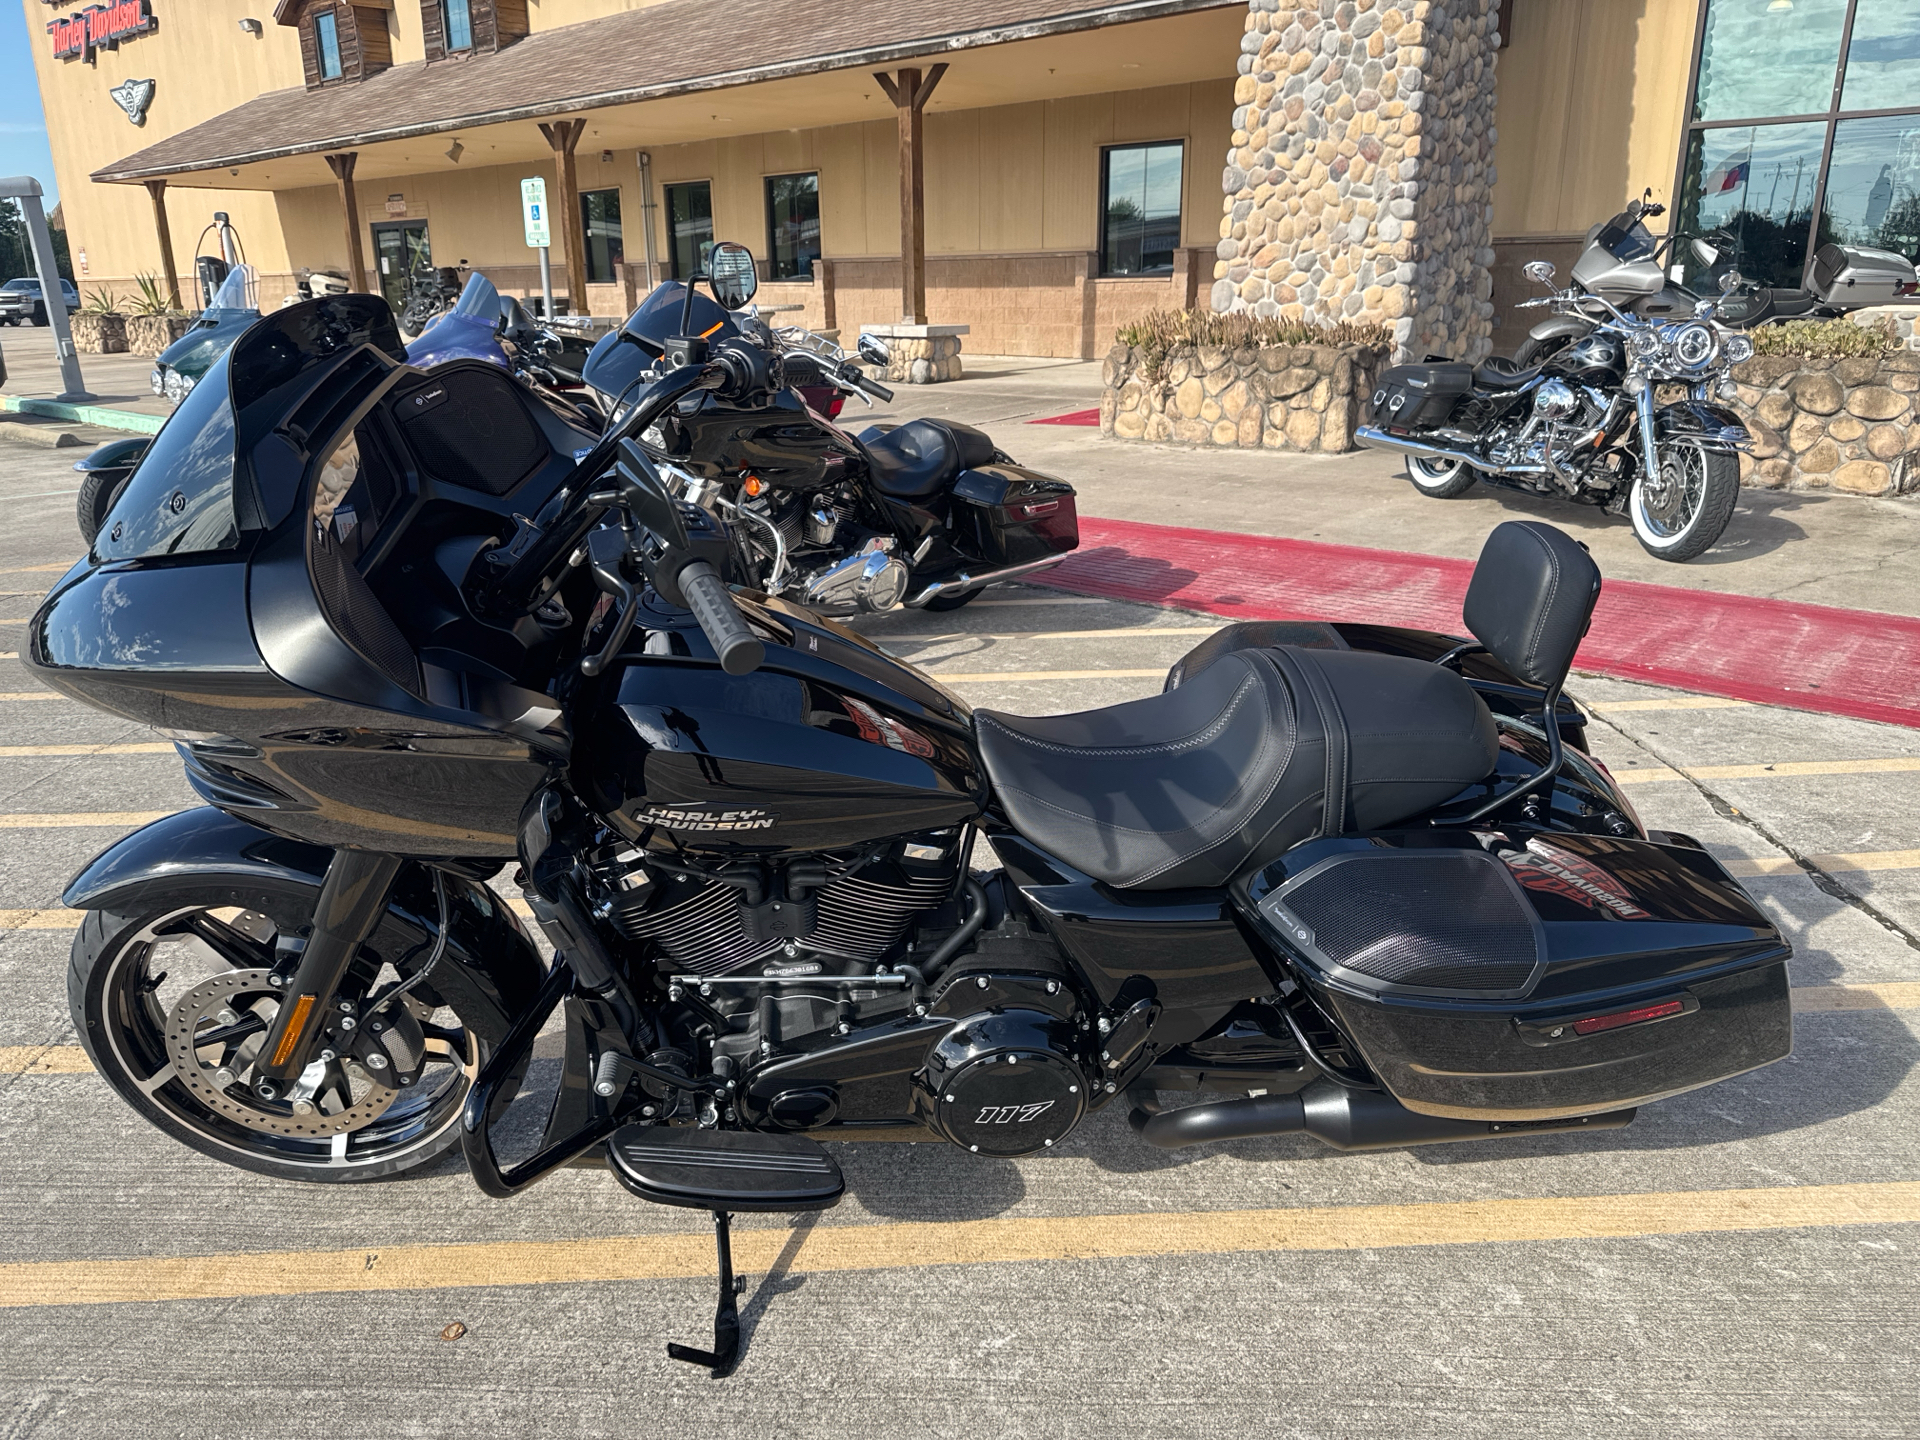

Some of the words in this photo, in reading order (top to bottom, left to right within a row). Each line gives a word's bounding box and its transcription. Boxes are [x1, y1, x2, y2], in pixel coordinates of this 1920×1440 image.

[636, 814, 774, 831] DAVIDSON
[648, 808, 766, 821] HARLEY-
[975, 1100, 1055, 1123] 117
